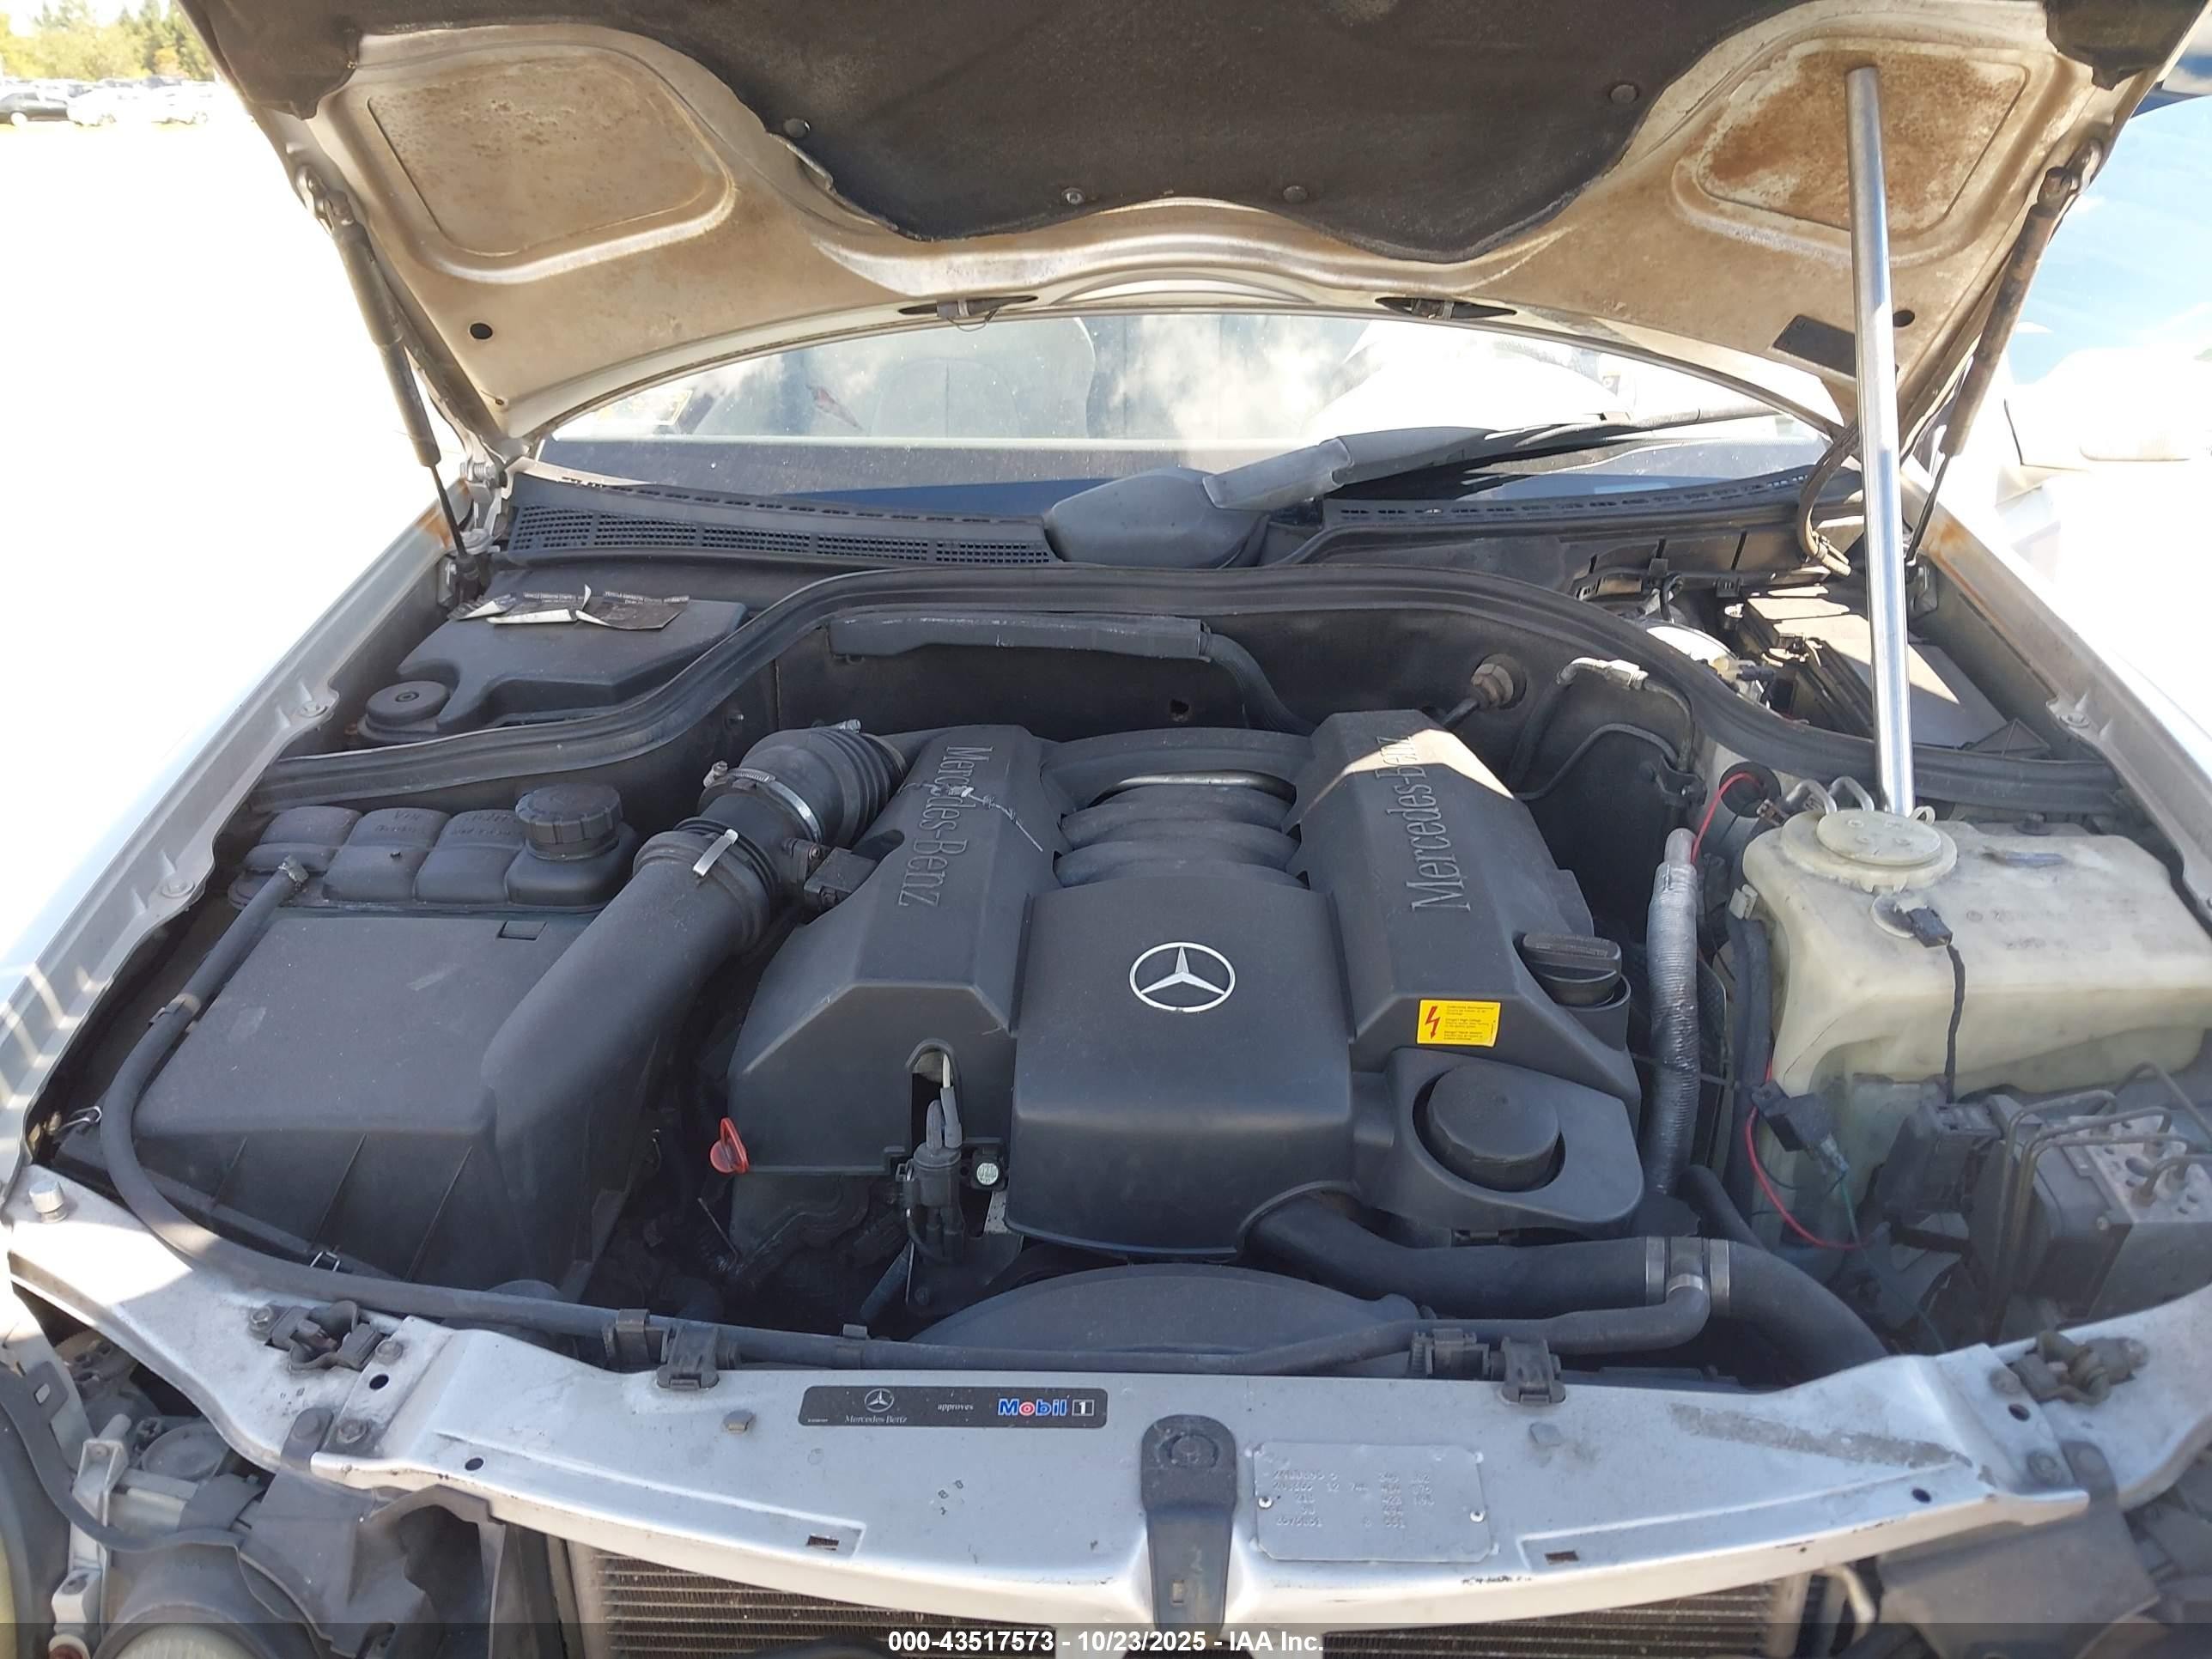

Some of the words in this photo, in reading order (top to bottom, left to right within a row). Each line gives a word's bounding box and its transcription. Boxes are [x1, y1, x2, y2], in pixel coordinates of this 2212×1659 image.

[1375, 735, 1471, 912] Mercedes-Benz
[938, 1401, 974, 1411] approves
[998, 1398, 1067, 1416] Mobil
